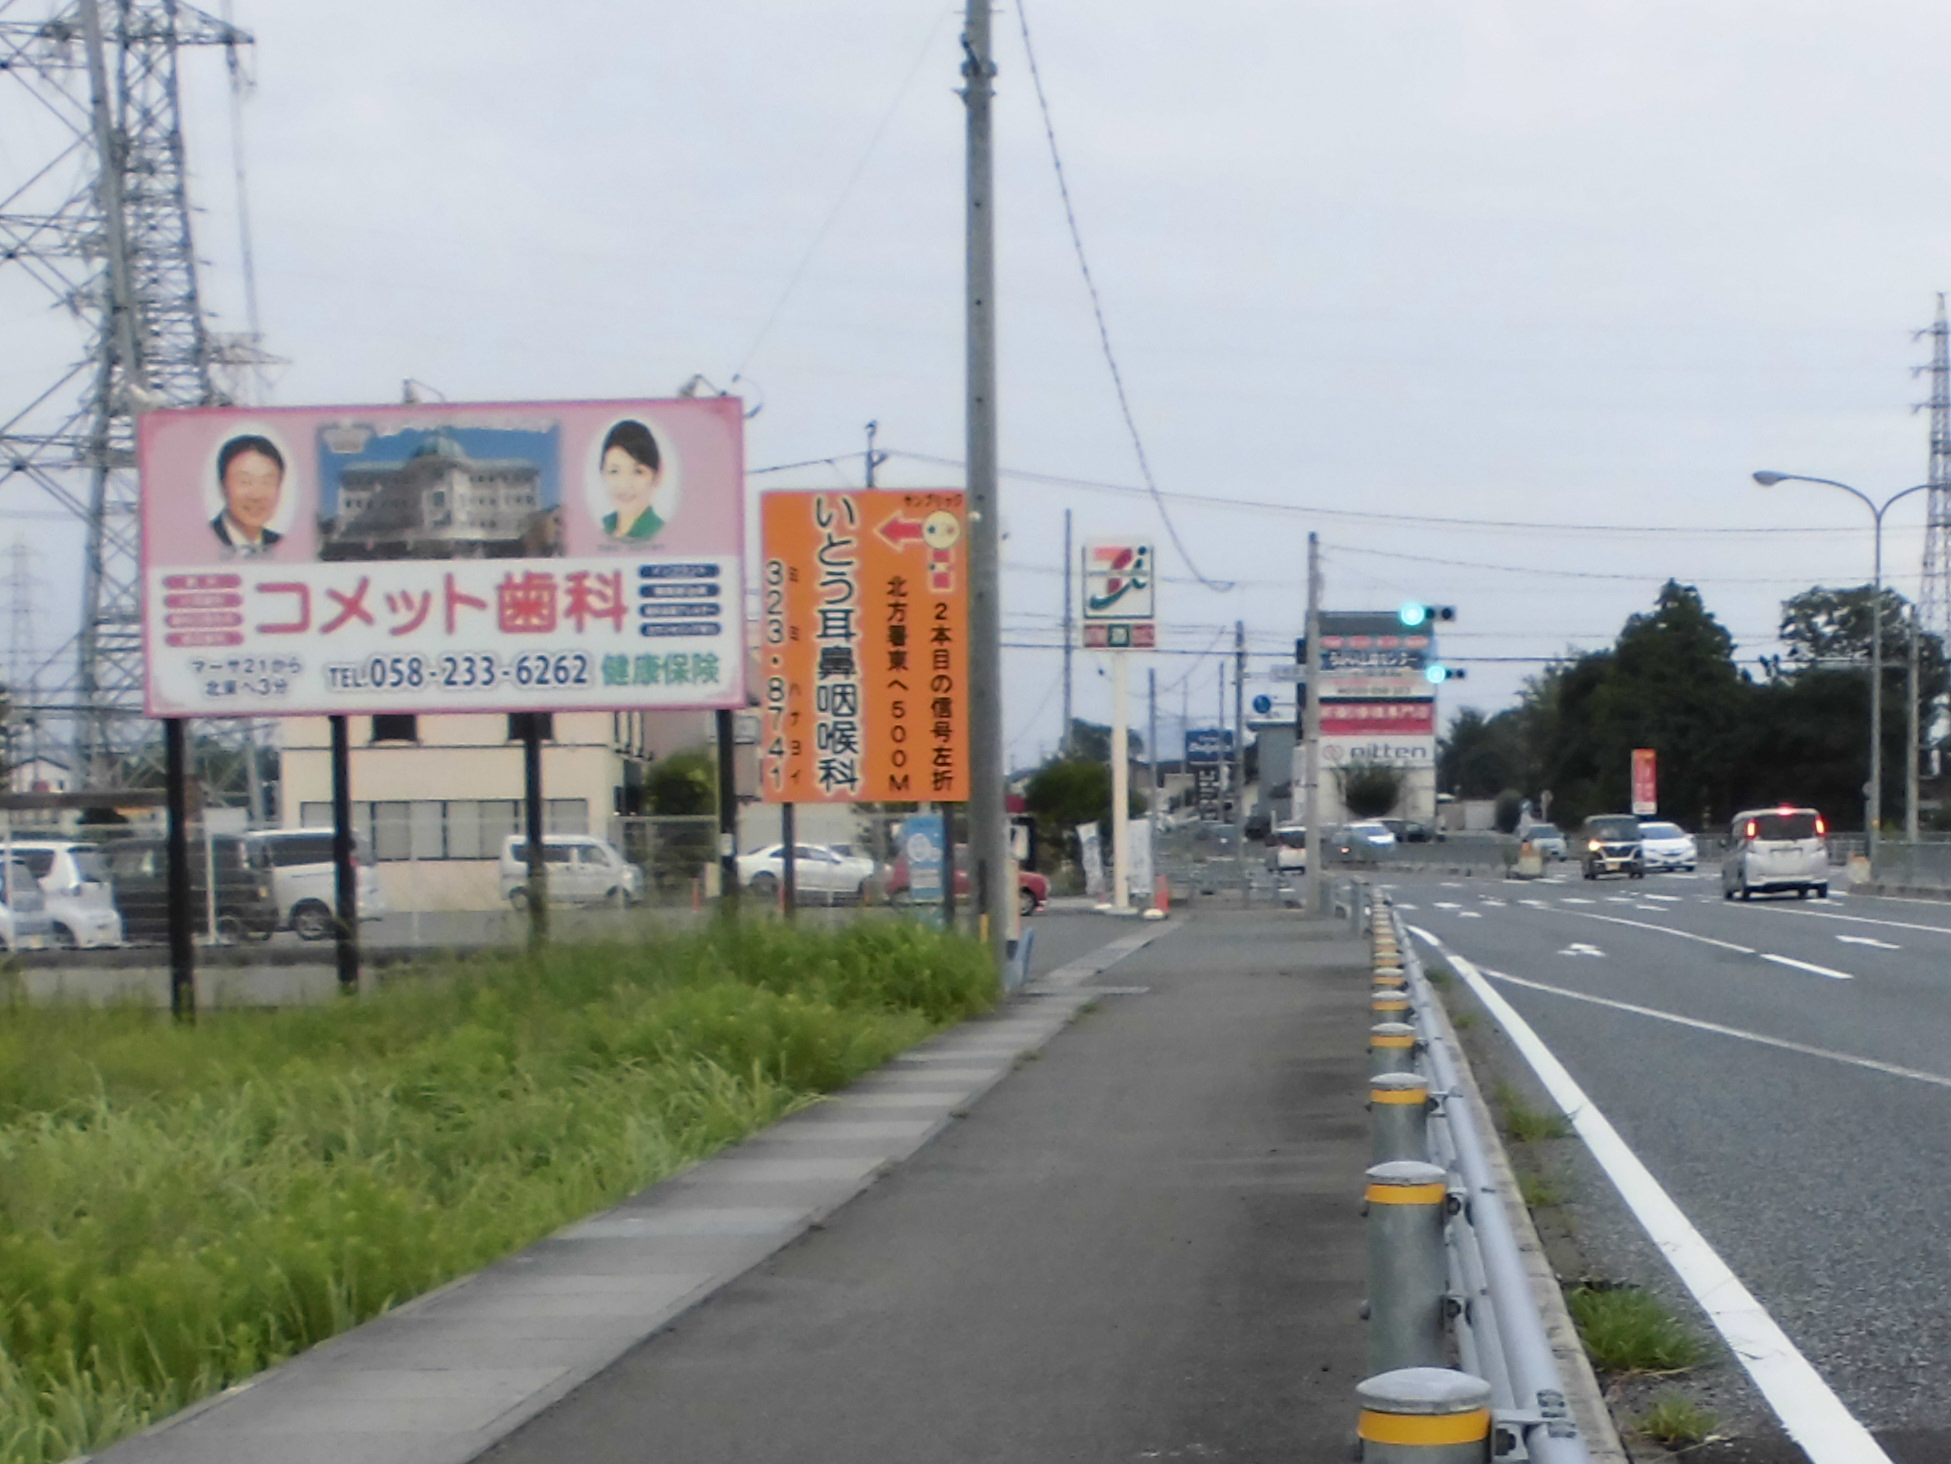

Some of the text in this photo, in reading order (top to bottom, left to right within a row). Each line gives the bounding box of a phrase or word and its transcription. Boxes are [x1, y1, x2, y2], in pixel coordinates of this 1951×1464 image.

[254, 570, 627, 637] コメット歯科
[601, 651, 720, 686] 健康保険
[815, 496, 859, 792] いとう耳鼻咽喉科
